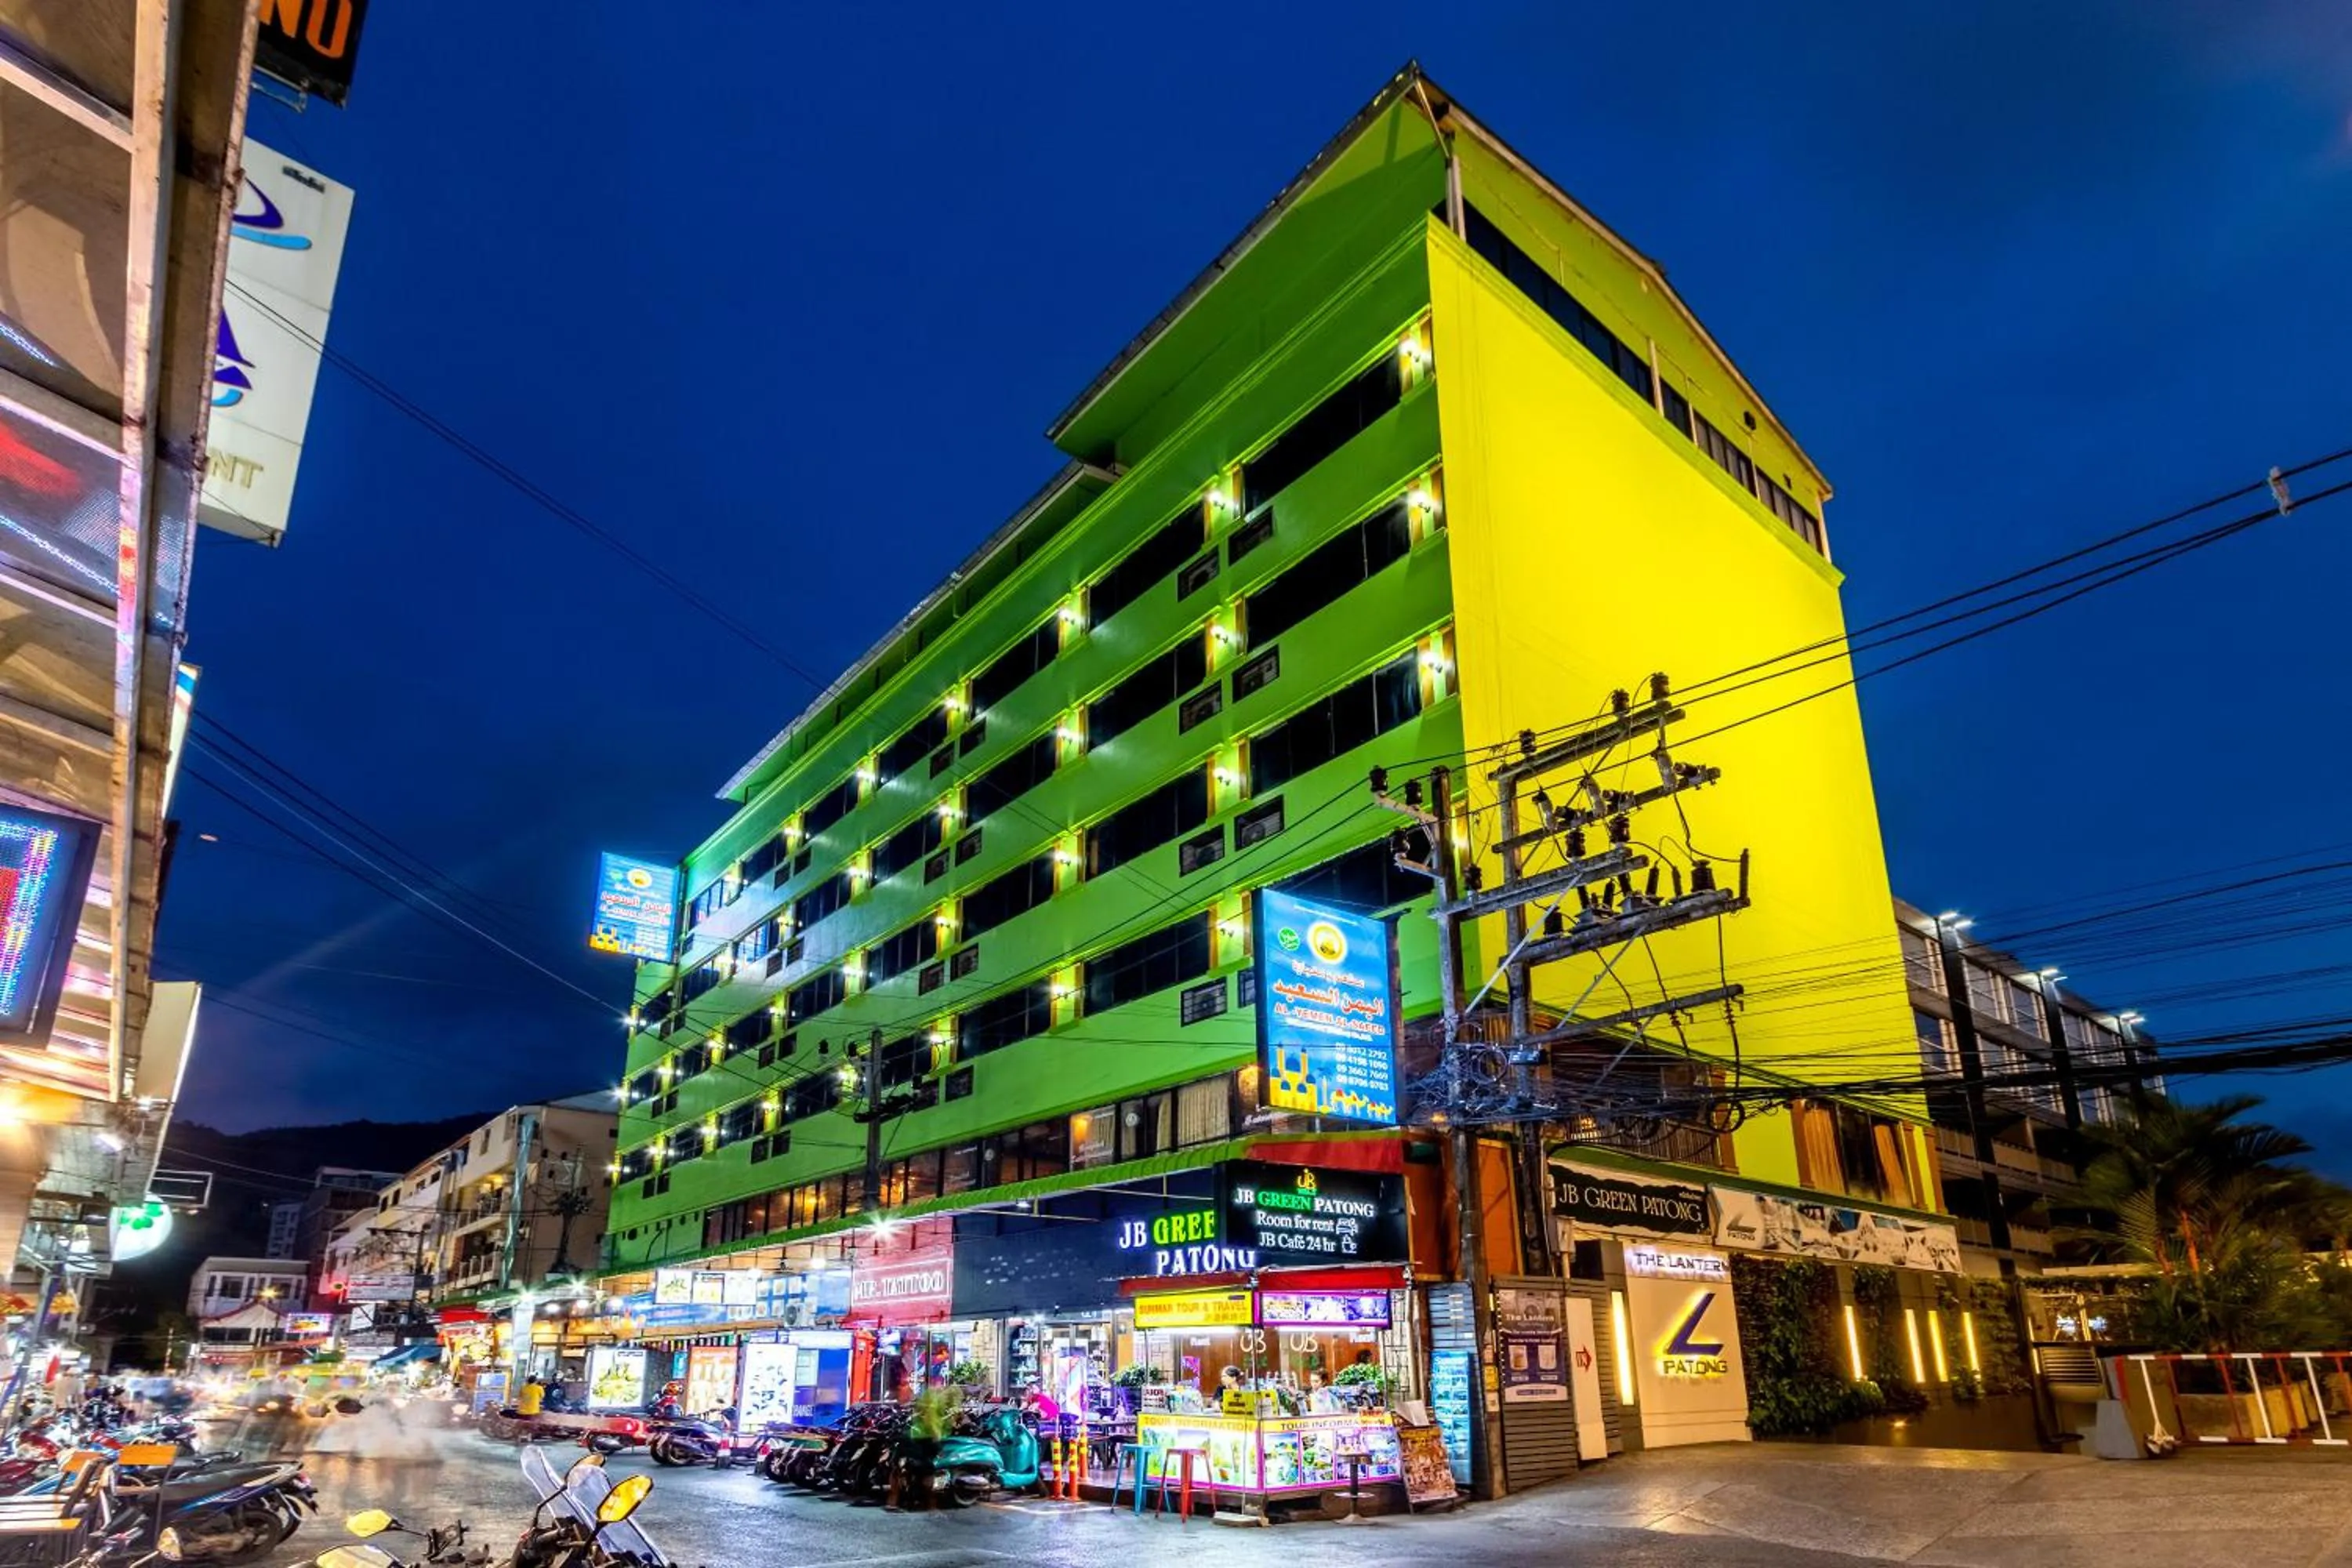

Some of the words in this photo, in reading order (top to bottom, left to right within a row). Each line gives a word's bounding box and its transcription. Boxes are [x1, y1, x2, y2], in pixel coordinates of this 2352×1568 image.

[1235, 1188, 1254, 1203] JB
[1258, 1192, 1312, 1210] GREEN
[1314, 1197, 1374, 1217] PATONG
[1559, 1184, 1579, 1204] JB
[1584, 1187, 1638, 1212] GREEN
[1642, 1196, 1702, 1222] PATONG
[1119, 1221, 1147, 1248] JB
[1153, 1210, 1214, 1245] GREE
[1256, 1210, 1292, 1228] Room
[1294, 1215, 1311, 1229] for
[1312, 1220, 1334, 1232] rent
[1259, 1232, 1276, 1247] JB
[1307, 1236, 1322, 1250] 24
[1323, 1237, 1336, 1252] hr
[1635, 1253, 1664, 1267] THE
[1668, 1256, 1730, 1272] LANTERN
[1663, 1359, 1727, 1374] PATONG
[1280, 1421, 1309, 1431] TOUR
